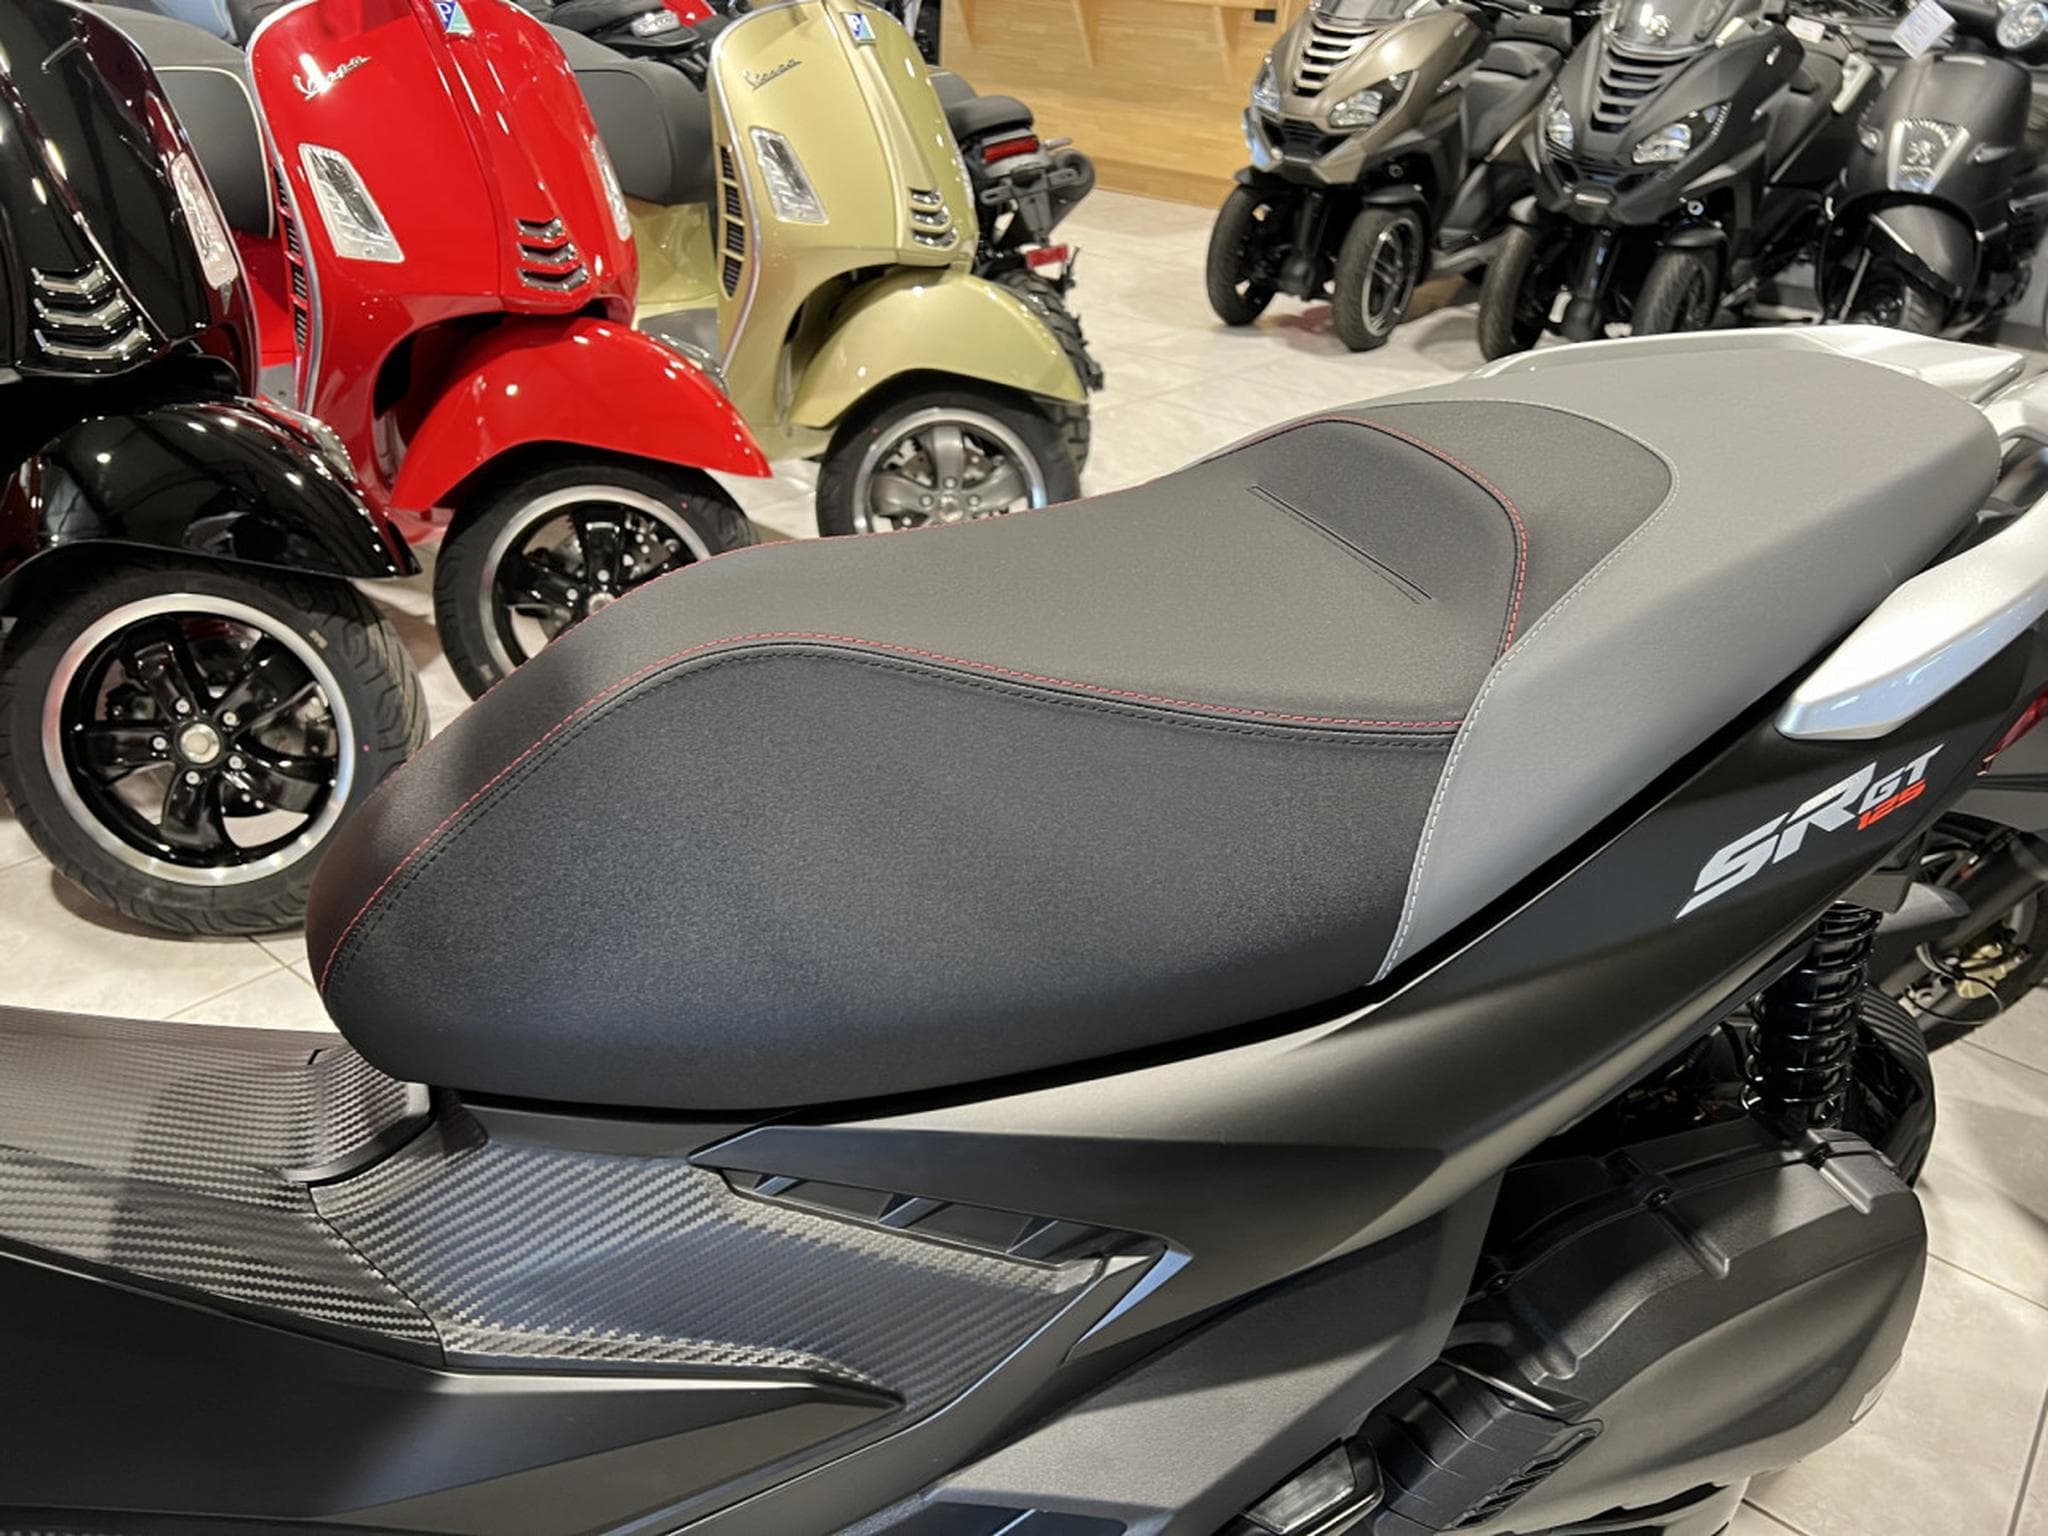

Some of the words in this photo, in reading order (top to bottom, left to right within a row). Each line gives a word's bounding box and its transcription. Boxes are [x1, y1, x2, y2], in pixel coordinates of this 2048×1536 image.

[292, 54, 371, 101] Vspa
[1675, 761, 1878, 920] SR
[1858, 743, 1945, 815] GT
[1857, 778, 1927, 832] 125
